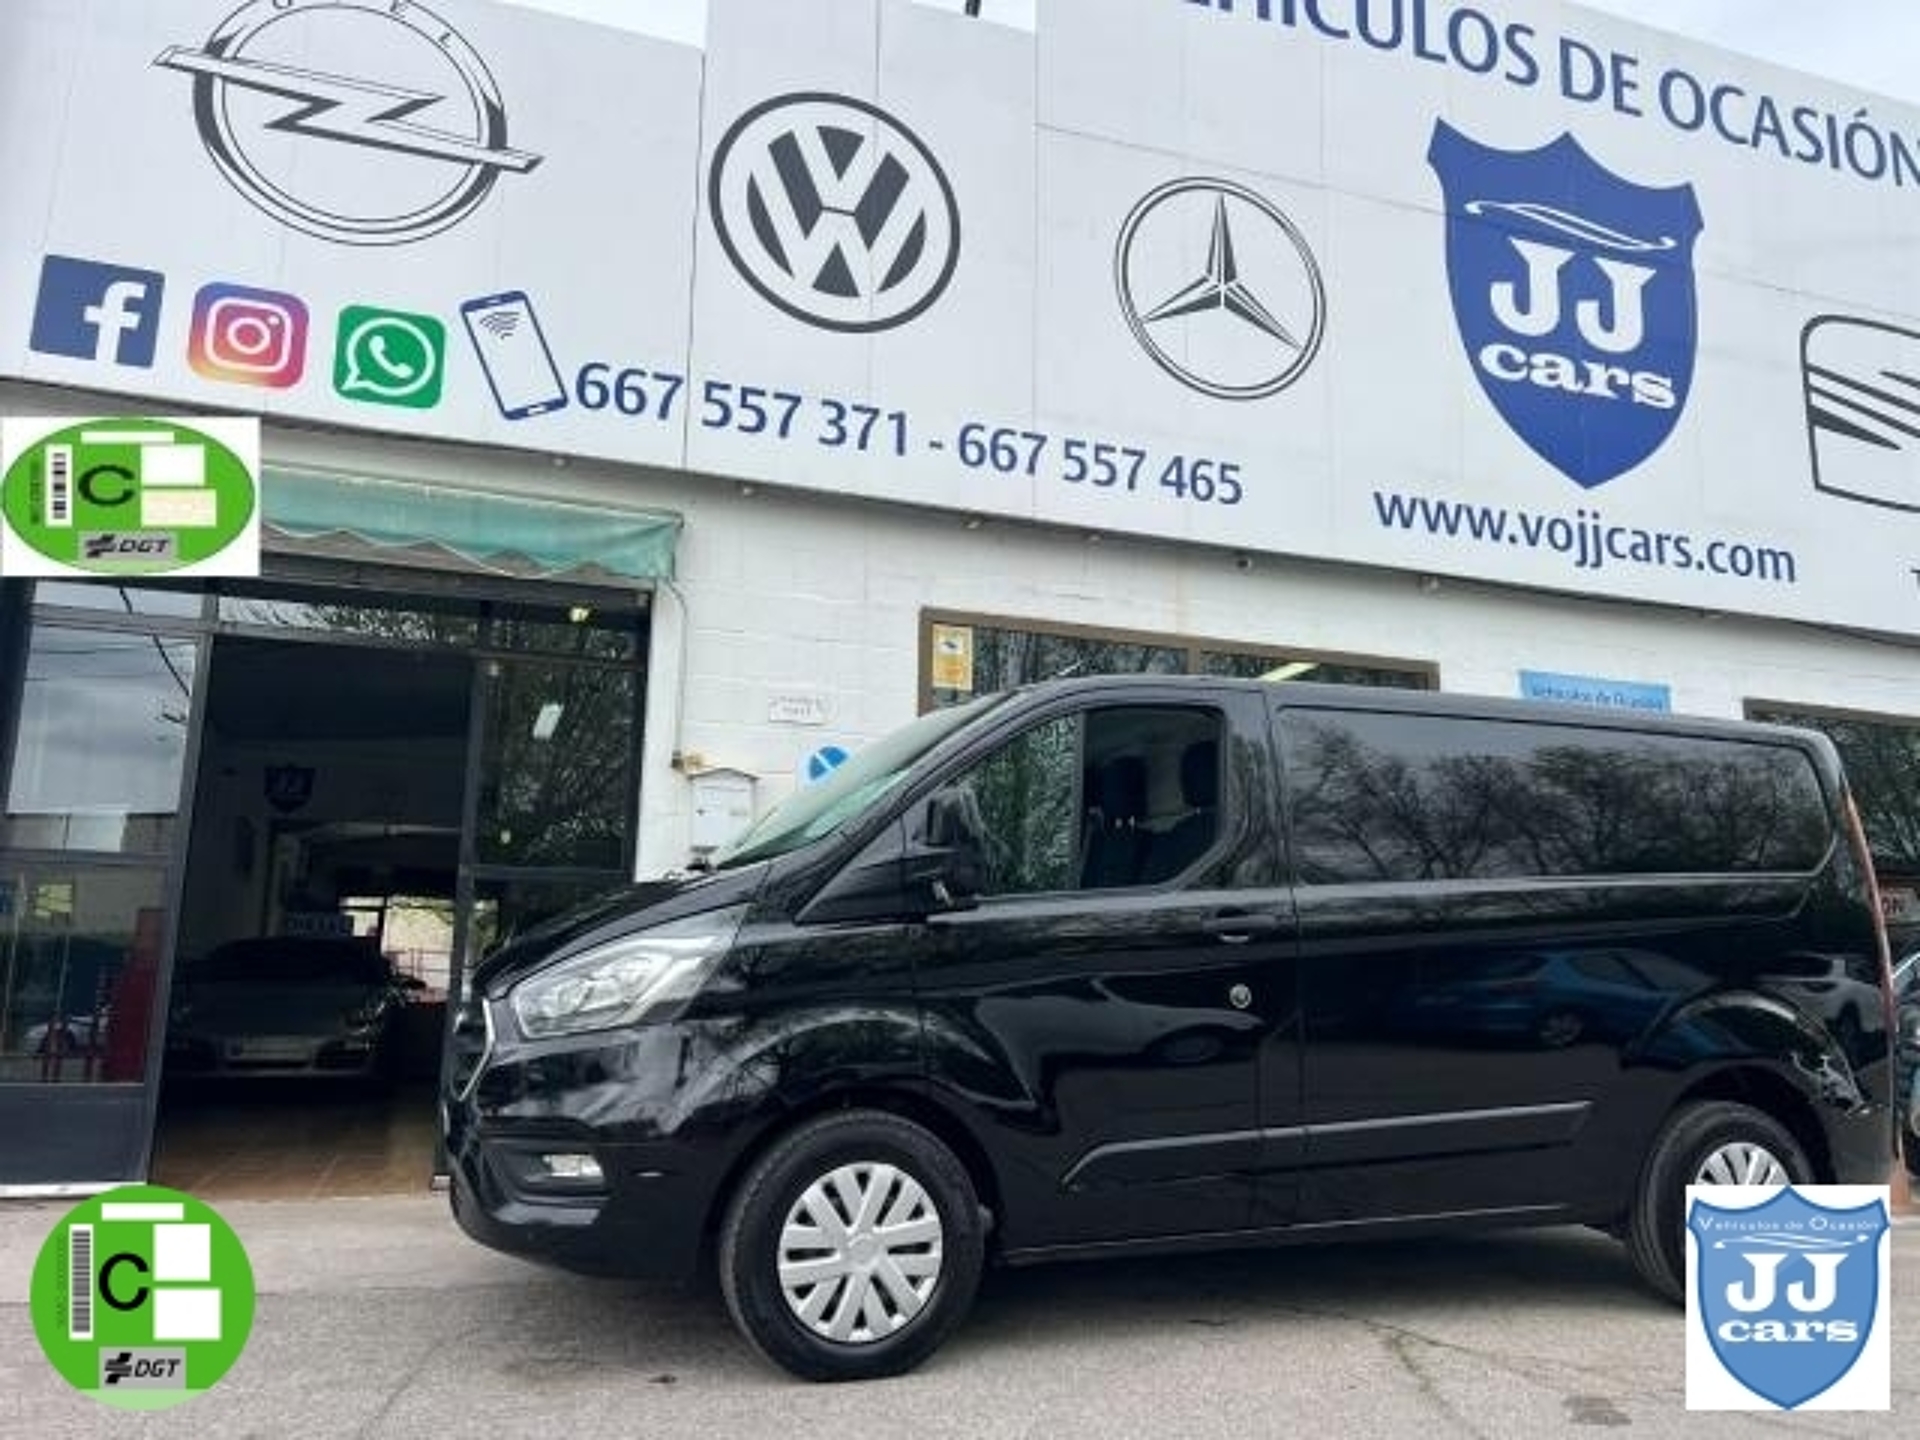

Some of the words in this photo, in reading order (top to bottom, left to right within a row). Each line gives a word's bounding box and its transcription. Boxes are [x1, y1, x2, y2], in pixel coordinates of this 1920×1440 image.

[1558, 36, 1644, 118] DE
[1658, 68, 1920, 187] OCASIÓN
[1488, 237, 1657, 353] JJ
[575, 361, 684, 421] 667
[701, 380, 801, 439] 557
[818, 398, 907, 457] 371
[958, 422, 1048, 476] 667
[1062, 439, 1146, 491] 557
[1160, 455, 1244, 505] 465
[1479, 344, 1676, 411] cars
[1373, 490, 1798, 583] www.vojjcars.com
